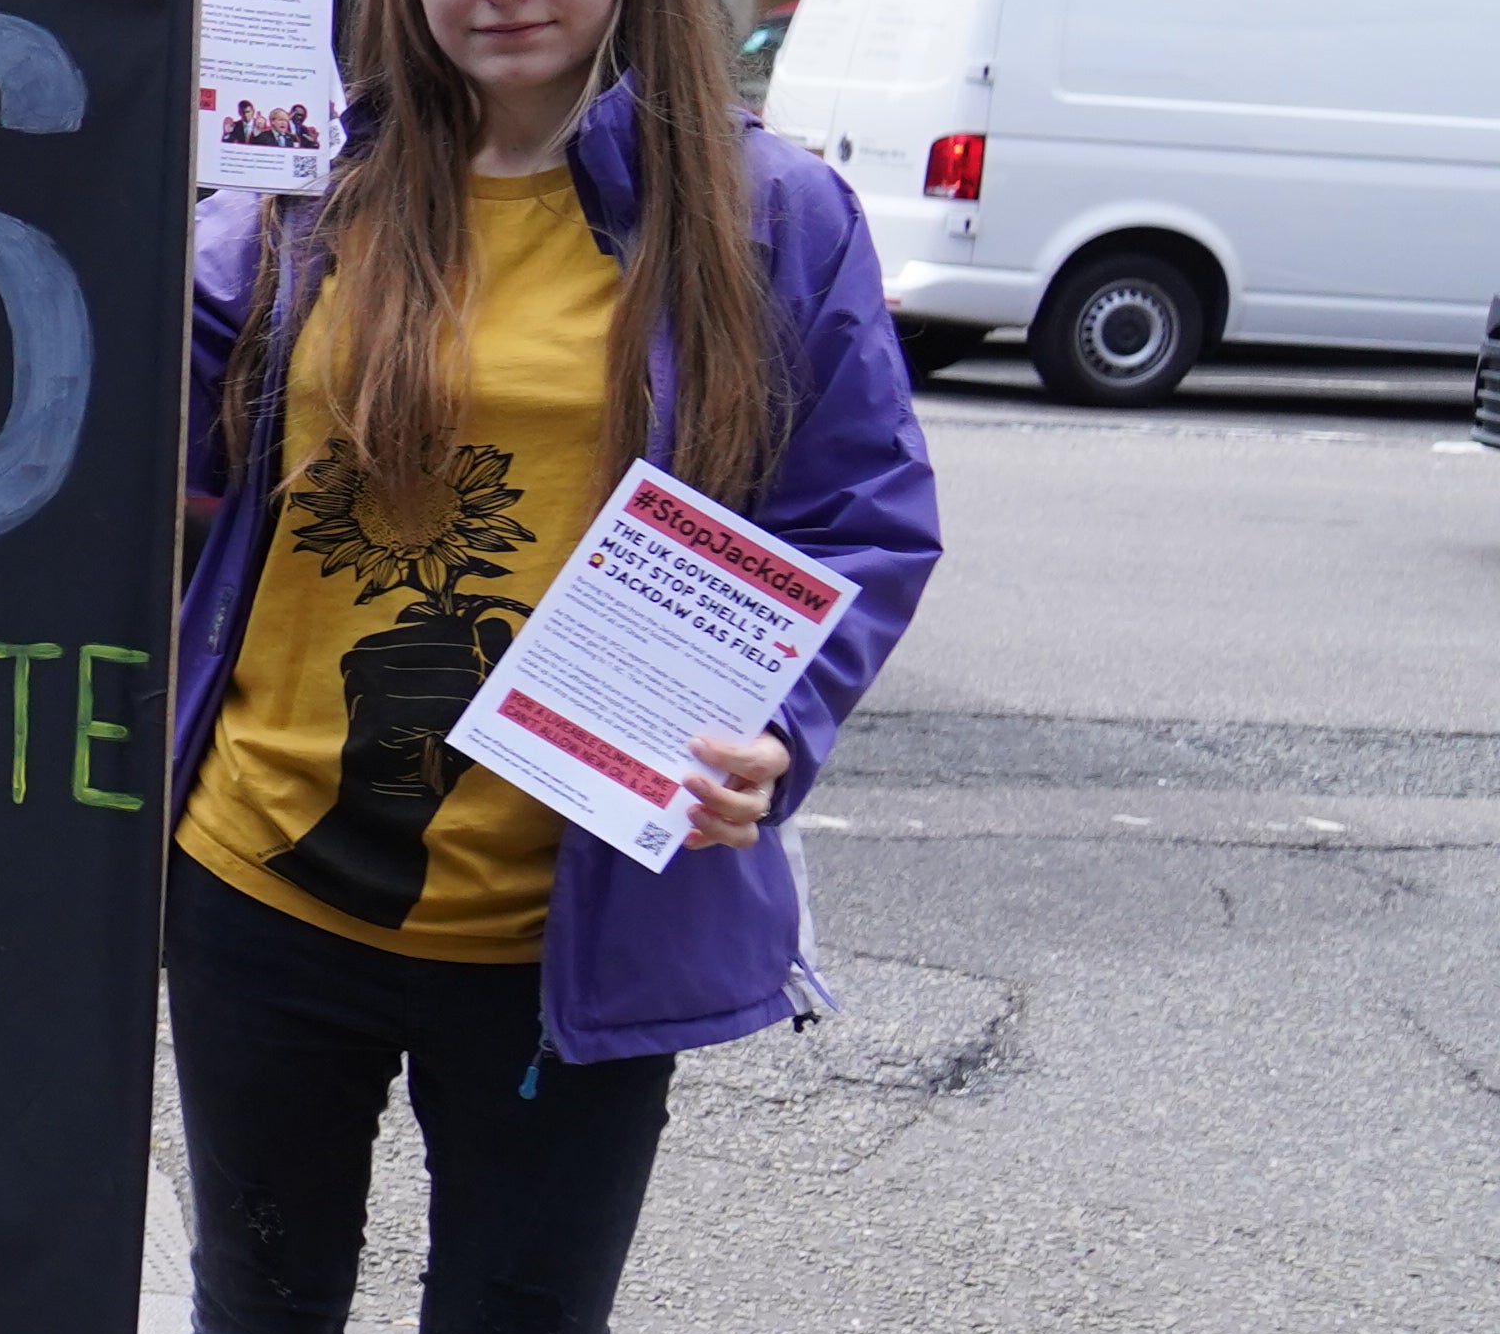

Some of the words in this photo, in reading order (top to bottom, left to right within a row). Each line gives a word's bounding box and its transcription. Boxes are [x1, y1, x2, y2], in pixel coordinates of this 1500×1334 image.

[600, 537, 650, 570] MUST
[649, 566, 696, 598] STOP
[697, 594, 767, 642] SHELL'S
[613, 520, 646, 547] THE
[648, 540, 674, 562] UK
[674, 557, 795, 632] GOVERNMENT
[633, 489, 829, 612] #StopJackdaw
[604, 565, 693, 620] JACKDAW
[692, 616, 730, 643] GAS
[730, 638, 782, 674] FIELD
